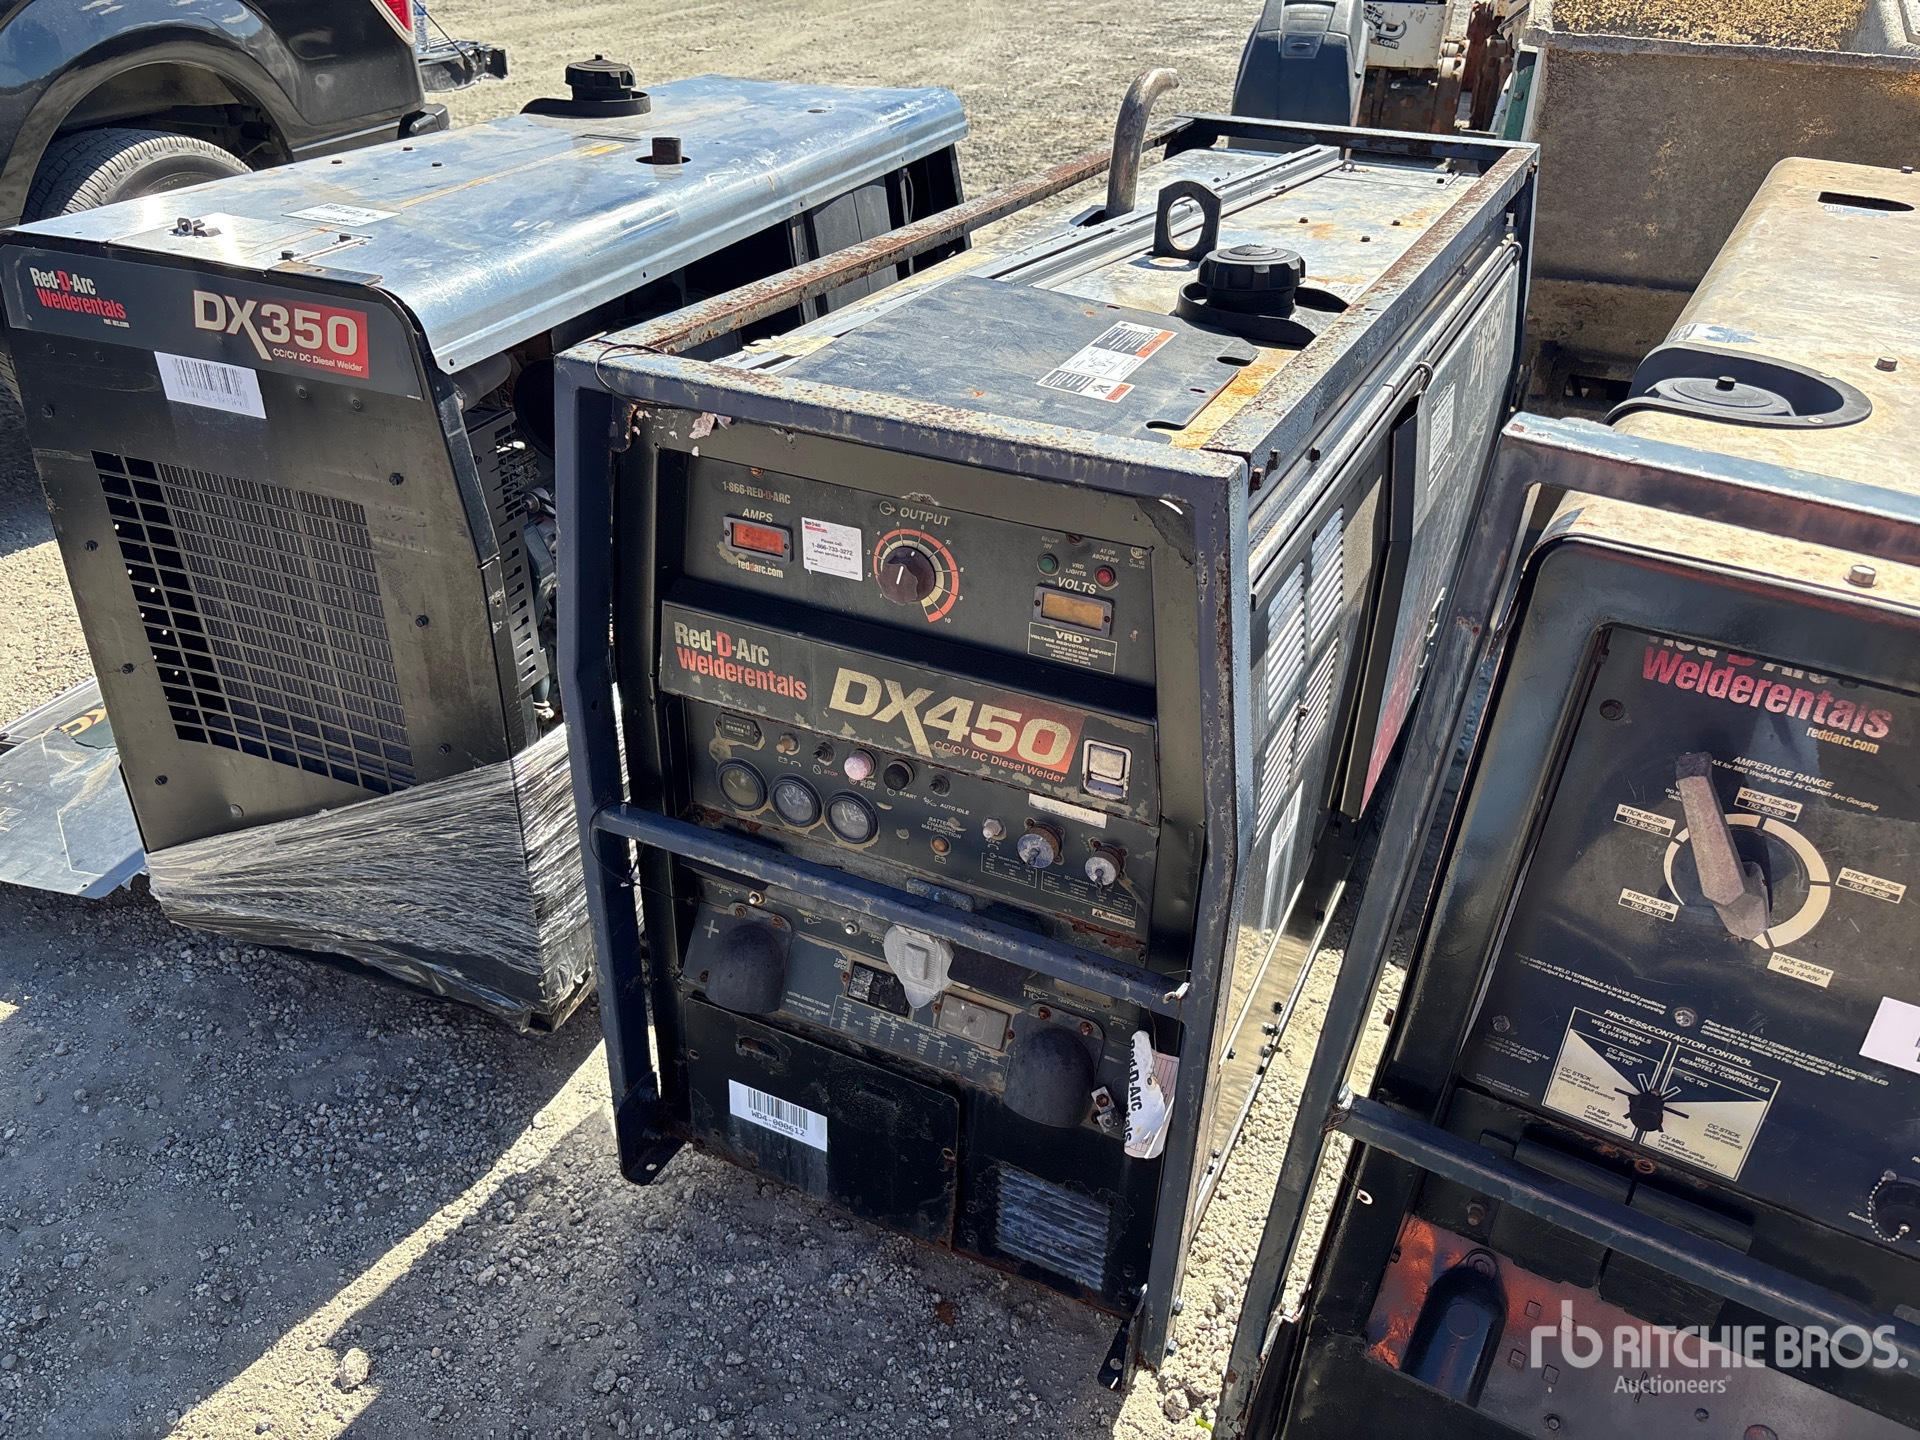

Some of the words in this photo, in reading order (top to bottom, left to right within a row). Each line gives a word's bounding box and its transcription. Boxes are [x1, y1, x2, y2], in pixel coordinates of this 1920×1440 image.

[29, 267, 96, 295] Red-D-Arc
[36, 288, 127, 319] Welderentals
[193, 290, 358, 361] DX350
[273, 348, 298, 360] CC/CV
[299, 352, 311, 363] DC
[312, 355, 335, 368] Diesel
[336, 359, 363, 372] Welder
[722, 481, 791, 505] 1-866-RED-D-ARC
[742, 508, 773, 523] AMPS
[900, 507, 951, 526] OUTPUT
[1072, 562, 1084, 570] VRD
[1091, 553, 1110, 562] ABOVE
[738, 560, 784, 579] reddarc.com
[1065, 568, 1087, 577] LIGHTS
[1057, 577, 1097, 595] VOLTS
[674, 621, 770, 667] Red-D-Arc
[1030, 634, 1055, 643] VOLTAGE
[1056, 640, 1089, 651] REDUCTION
[676, 646, 808, 701] Welderentals
[1642, 645, 1893, 739] Welderentals
[828, 667, 1072, 765] DX450
[1806, 726, 1880, 754] reddarc.com
[933, 740, 970, 757] CC/CV
[970, 750, 989, 762] DC
[990, 756, 1025, 772] Diesel
[1026, 764, 1066, 783] Welder
[823, 769, 839, 777] STOP
[1732, 756, 1794, 779] AMPERAGE
[1795, 772, 1834, 790] RANGE
[859, 782, 875, 790] PLUG
[899, 791, 917, 799] START
[1723, 762, 1733, 770] for
[1733, 765, 1748, 775] MIG
[1749, 769, 1777, 784] Welding
[1777, 776, 1793, 786] and
[1793, 781, 1804, 790] Air
[1804, 784, 1832, 797] Carbon
[1832, 791, 1846, 801] Arc
[1846, 796, 1880, 812] Gouging
[1741, 790, 1766, 803] STICK
[1767, 797, 1798, 810] 125-400
[1746, 801, 1761, 811] TIG
[1761, 805, 1786, 817] 40-330
[939, 803, 956, 812] AUTO
[956, 807, 970, 816] IDLE
[1620, 807, 1642, 818] STICK
[1643, 812, 1667, 825] 85-250
[921, 823, 962, 839] MALFUNCTION
[928, 817, 952, 827] BATTER
[1625, 817, 1637, 825] TIG
[1637, 820, 1661, 832] 30-220
[1844, 871, 1869, 883] STICK
[1871, 879, 1901, 892] 185-525
[1848, 882, 1862, 890] TIG
[1862, 886, 1890, 898] 60-450
[1626, 891, 1649, 903] STICK
[1649, 898, 1672, 911] 55-125
[1630, 901, 1642, 911] TIG
[1642, 905, 1667, 918] 20-110
[1773, 954, 1797, 967] STICK
[1797, 962, 1831, 977] 300-MAX
[1777, 965, 1794, 975] MIG
[1794, 969, 1821, 983] 14-40V
[1529, 957, 1547, 967] switch
[1553, 965, 1570, 975] WELD
[1571, 970, 1604, 987] TERMINALS
[1604, 982, 1631, 997] ALWAYS
[1630, 992, 1640, 1000] ON
[1640, 996, 1667, 1010] positions
[1541, 966, 1559, 978] output
[1580, 980, 1607, 994] whenever
[1607, 989, 1617, 997] the
[1616, 993, 1636, 1004] engine
[1641, 1003, 1665, 1015] running
[1591, 1018, 1611, 1029] WELD
[1612, 1024, 1652, 1045] TERMINALS
[1598, 1028, 1627, 1042] ALWAYS
[1628, 1039, 1641, 1047] ON
[1604, 1009, 1707, 1051] PROCESS/CONTACTOR
[1707, 1046, 1753, 1067] CONTROL
[1605, 1052, 1621, 1062] Start
[1621, 1057, 1633, 1066] TIG
[1619, 1051, 1643, 1064] Scratch
[1700, 1029, 1732, 1044] connected
[1738, 1041, 1749, 1050] the
[1749, 1045, 1773, 1058] Remote
[1780, 1056, 1793, 1064] Pin
[1792, 1061, 1826, 1076] Receptacle
[1702, 1024, 1730, 1039] positions
[1737, 1036, 1750, 1045] turn
[1749, 1040, 1765, 1050] weld
[1765, 1046, 1785, 1058] output
[1794, 1055, 1807, 1064] and
[1807, 1059, 1817, 1067] off
[1816, 1062, 1830, 1072] with
[1835, 1070, 1856, 1081] device
[1704, 1018, 1721, 1029] Place
[1722, 1023, 1741, 1035] switch
[1748, 1033, 1768, 1044] WELD
[1768, 1040, 1806, 1058] TERMINALS
[1805, 1053, 1843, 1070] REMOTELY
[1842, 1065, 1889, 1086] CONTROLLED
[1561, 1066, 1571, 1074] CC
[1571, 1069, 1592, 1081] STICK
[1679, 1057, 1720, 1075] REMOTELY
[1719, 1071, 1771, 1093] CONTROLLED
[1694, 1056, 1717, 1067] WELD
[1717, 1062, 1760, 1083] TERMINALS
[1558, 1076, 1577, 1087] remote
[1577, 1082, 1594, 1093] output
[1594, 1089, 1615, 1101] control)
[1559, 1071, 1573, 1080] (with
[1580, 1078, 1600, 1089] without
[1684, 1075, 1695, 1083] CC
[1695, 1079, 1709, 1088] TIG
[1586, 1104, 1598, 1112] CV
[1597, 1108, 1611, 1117] MIG
[751, 1109, 805, 1137] WD4-000612
[1606, 1118, 1628, 1129] sensing
[1707, 1123, 1718, 1131] CC
[1719, 1127, 1741, 1138] STICK
[1671, 1138, 1685, 1146] MIG
[1720, 1133, 1741, 1143] remote
[1720, 1138, 1743, 1150] control)
[1674, 1149, 1694, 1159] remote
[1689, 1150, 1705, 1159] using
